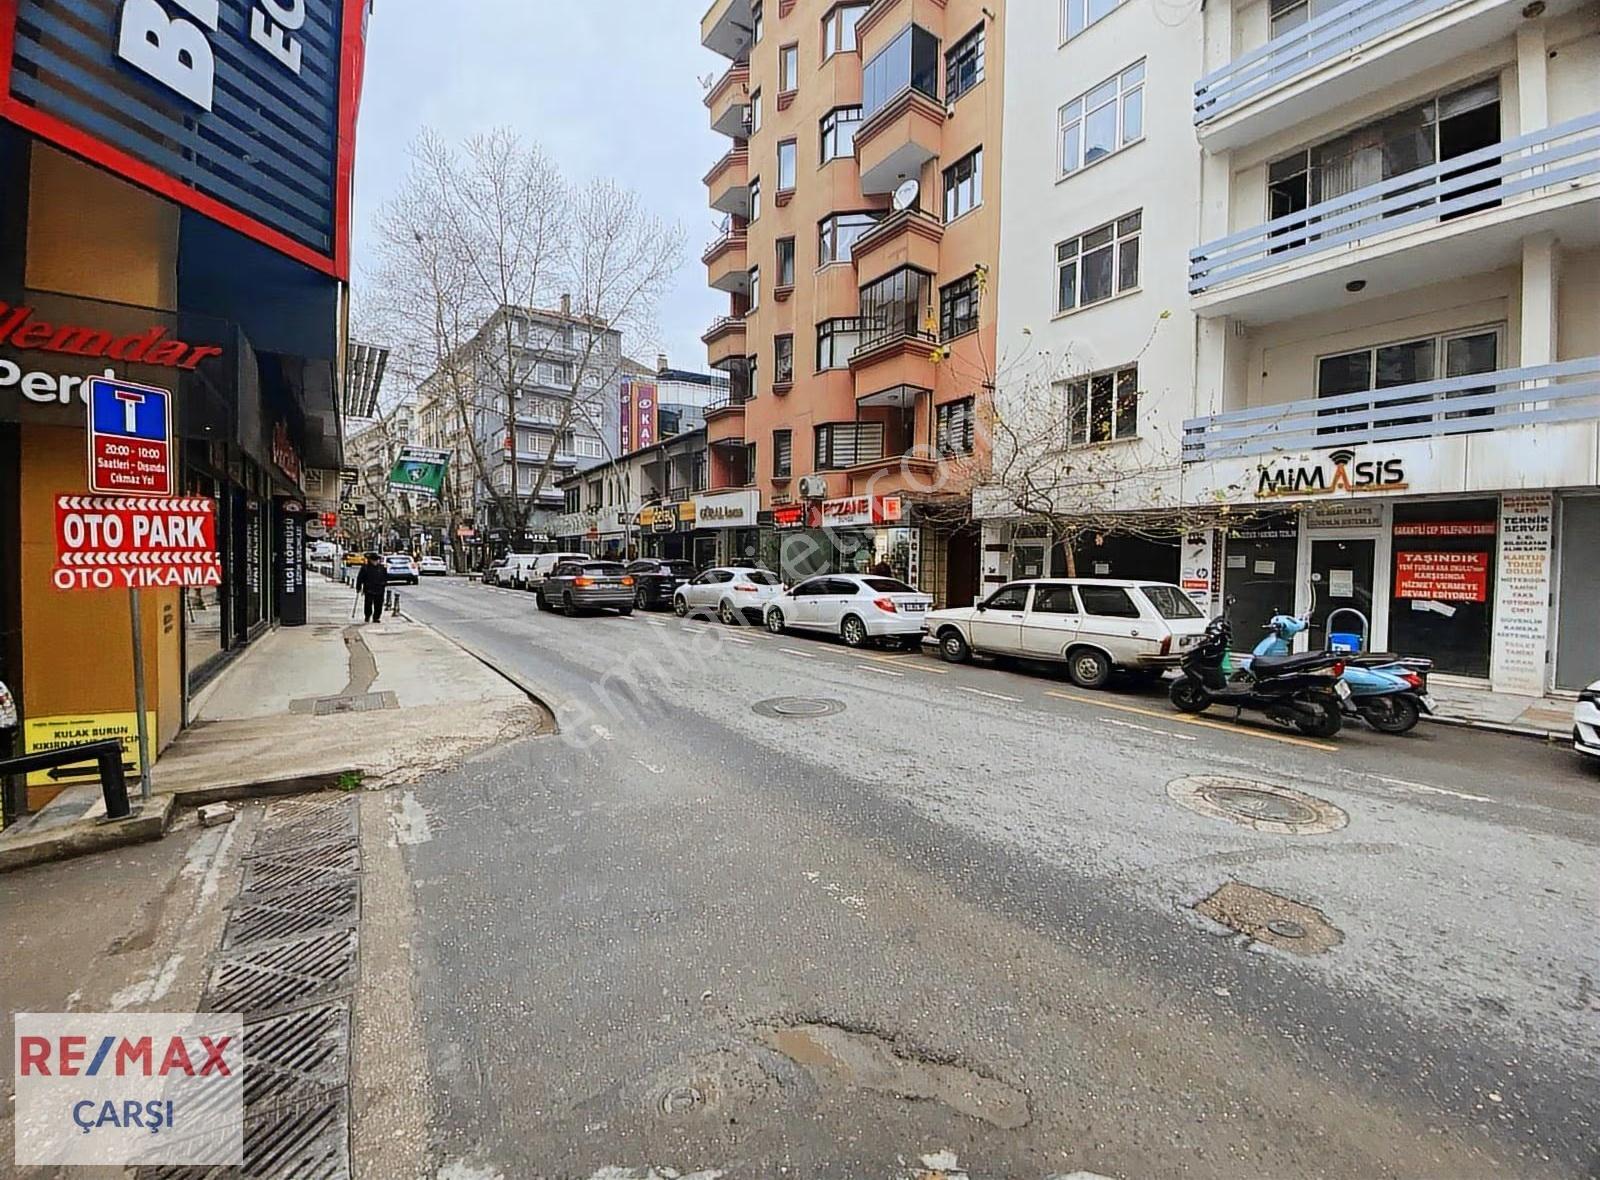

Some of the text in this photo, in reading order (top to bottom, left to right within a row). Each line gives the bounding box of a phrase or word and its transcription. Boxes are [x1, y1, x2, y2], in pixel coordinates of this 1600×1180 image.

[0, 302, 222, 369] lemdar
[1504, 514, 1549, 524] TEKNİK
[63, 514, 208, 548] OTO PARK
[1404, 553, 1479, 564] TAŞINDIK
[54, 564, 222, 589] OTO YIKAMA
[54, 729, 89, 739] KULAK
